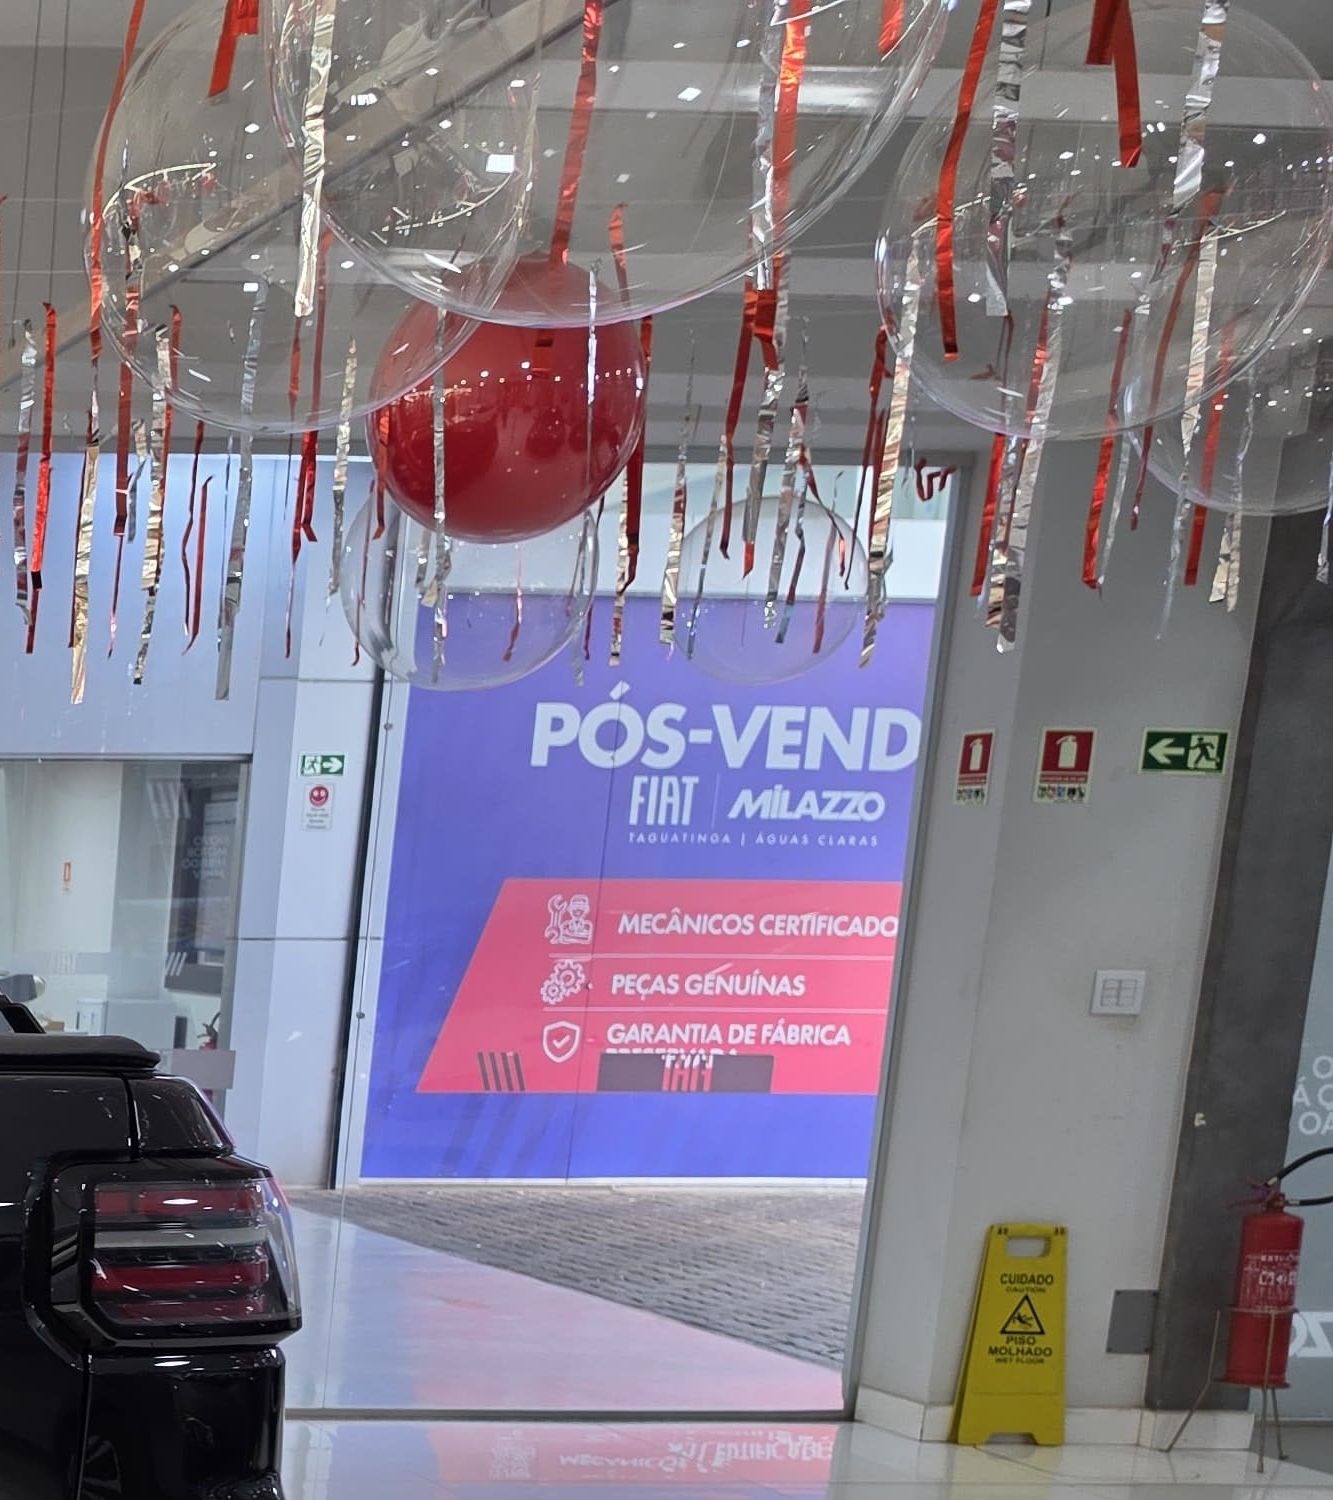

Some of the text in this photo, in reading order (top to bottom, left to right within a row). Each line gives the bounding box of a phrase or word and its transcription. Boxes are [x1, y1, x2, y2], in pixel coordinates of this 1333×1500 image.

[629, 776, 699, 826] FIAT
[629, 831, 879, 848] TAGUATINGA ÁGUAS CLARAS
[618, 907, 754, 936] MECÂNICOS
[611, 968, 806, 1000] PEÇAS GENUÍNAS
[607, 1017, 851, 1046] GARANTIA DE FÁBRICA
[1000, 1273, 1054, 1286] CUIDADO
[988, 1346, 1053, 1358] MOLHADO
[1006, 1335, 1036, 1346] PISO
